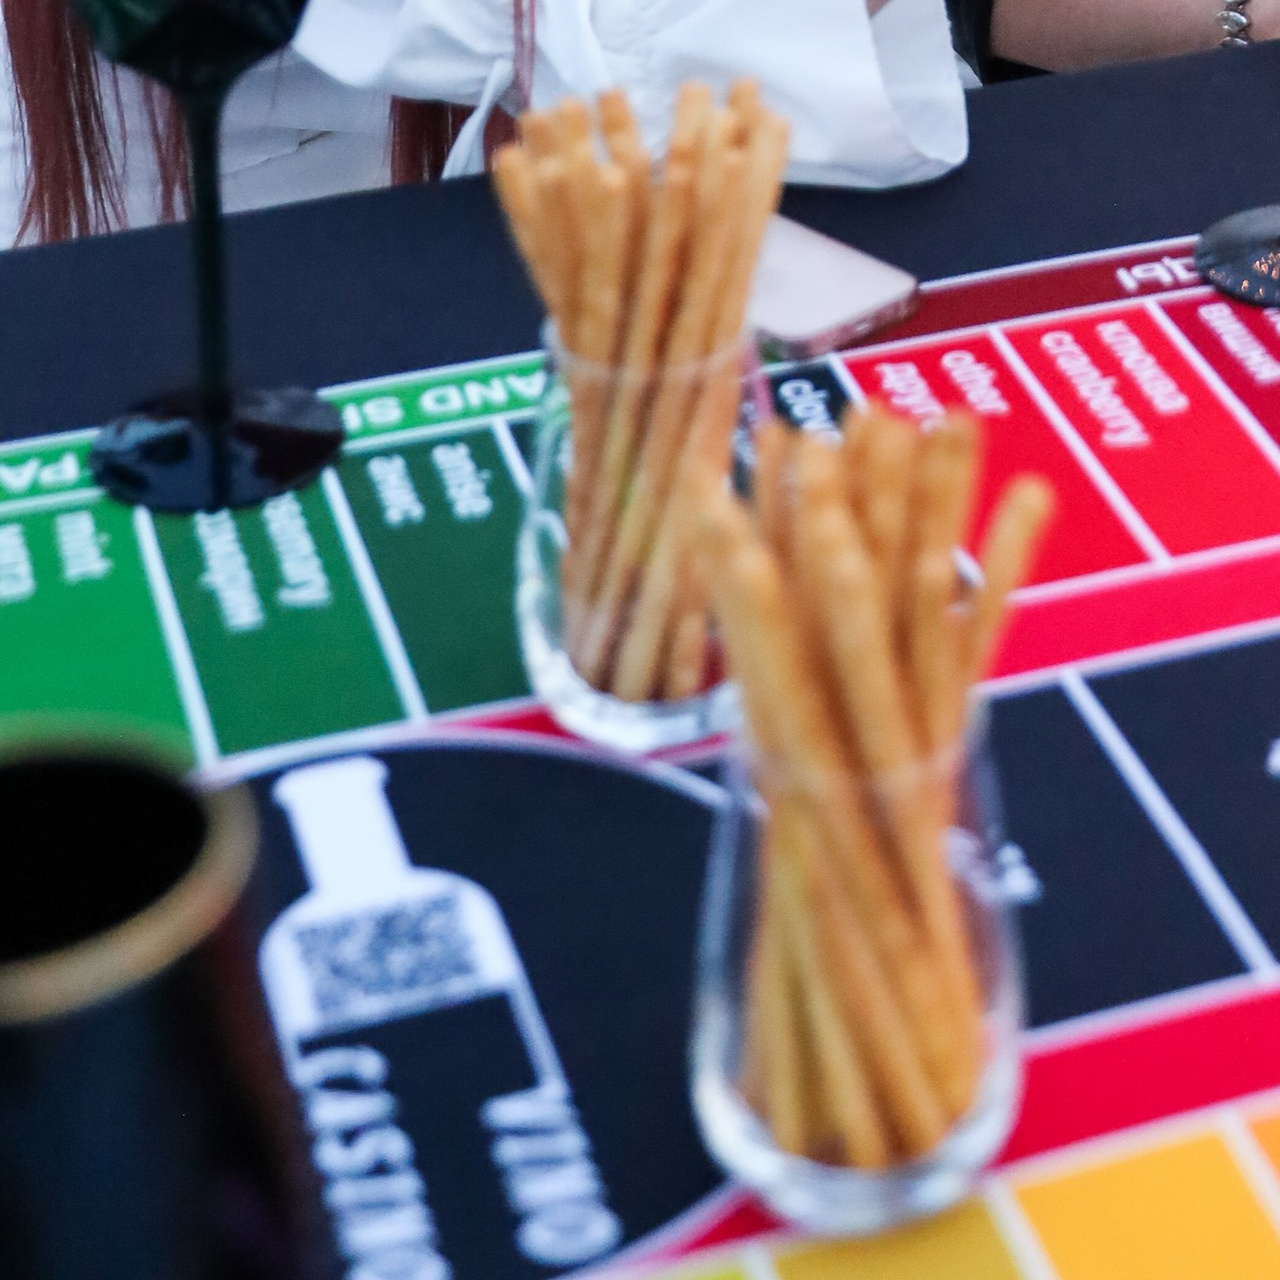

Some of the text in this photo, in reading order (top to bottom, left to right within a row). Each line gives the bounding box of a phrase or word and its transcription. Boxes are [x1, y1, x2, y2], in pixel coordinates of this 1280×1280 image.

[941, 351, 1011, 416] other
[1039, 332, 1150, 448] cranberry
[482, 1088, 622, 1267] VINO
